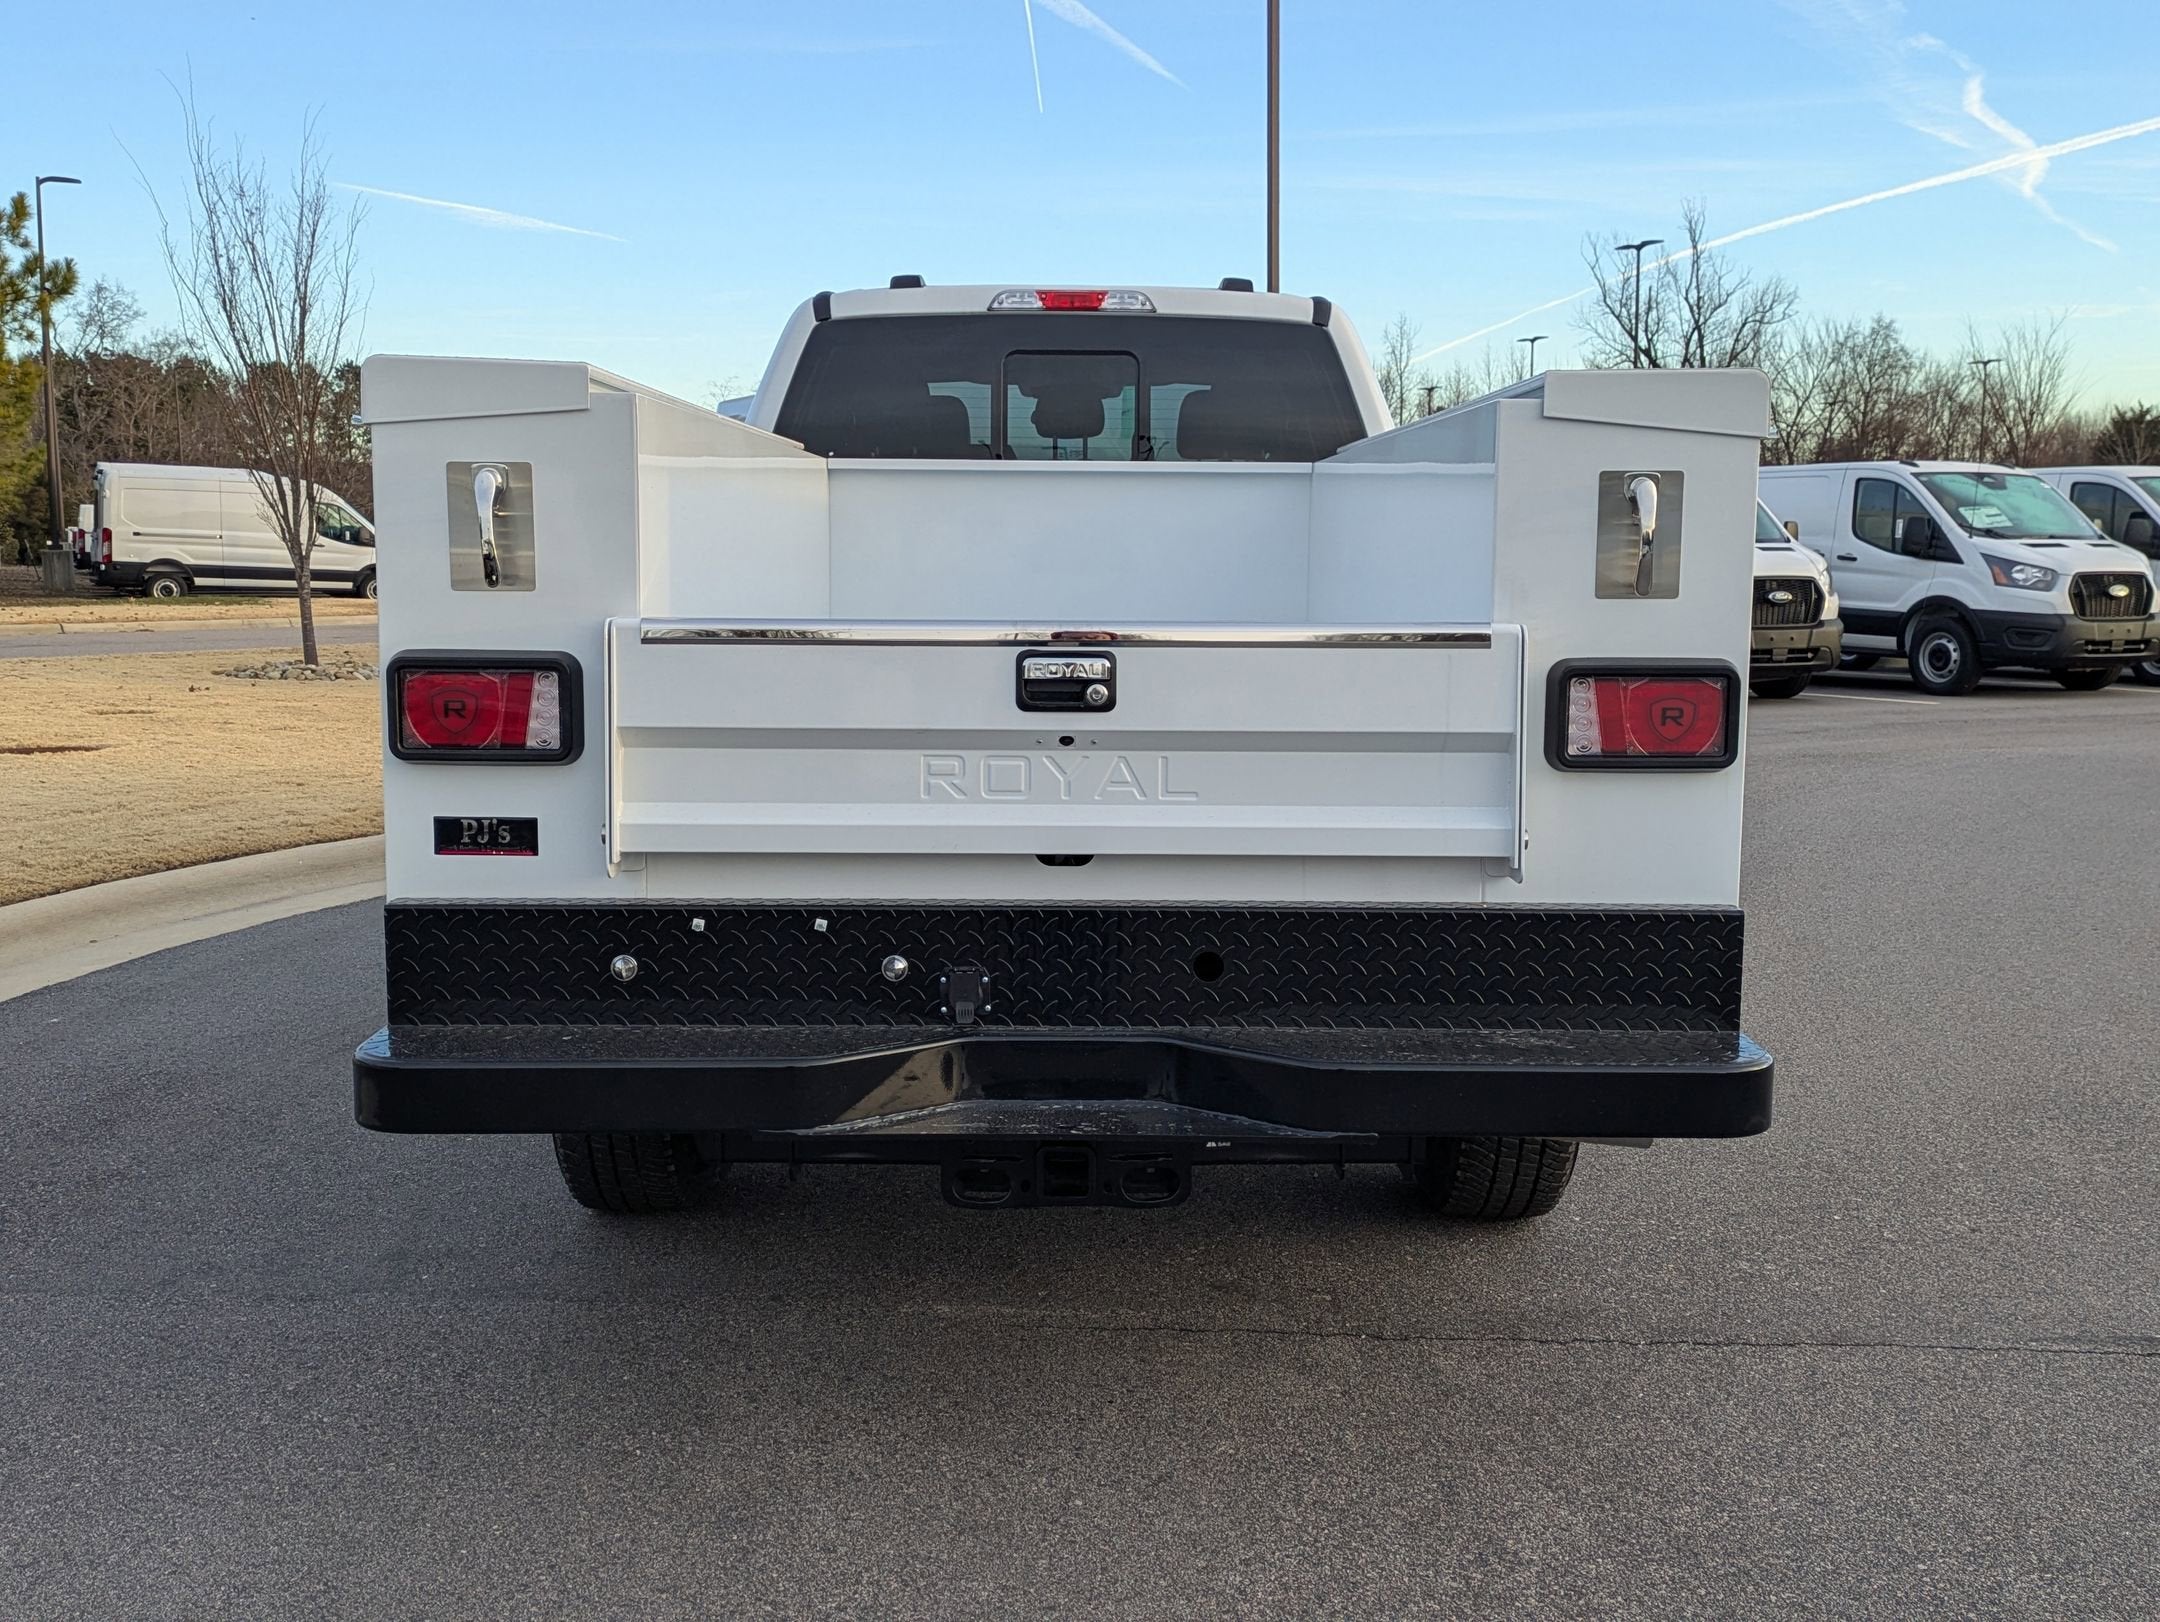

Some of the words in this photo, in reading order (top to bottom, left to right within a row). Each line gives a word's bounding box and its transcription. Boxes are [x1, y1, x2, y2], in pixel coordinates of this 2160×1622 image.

[1030, 662, 1106, 678] ROYAL
[443, 699, 467, 719] R
[1660, 707, 1684, 727] R
[920, 754, 1199, 800] ROYAL
[460, 818, 511, 844] PJ's
